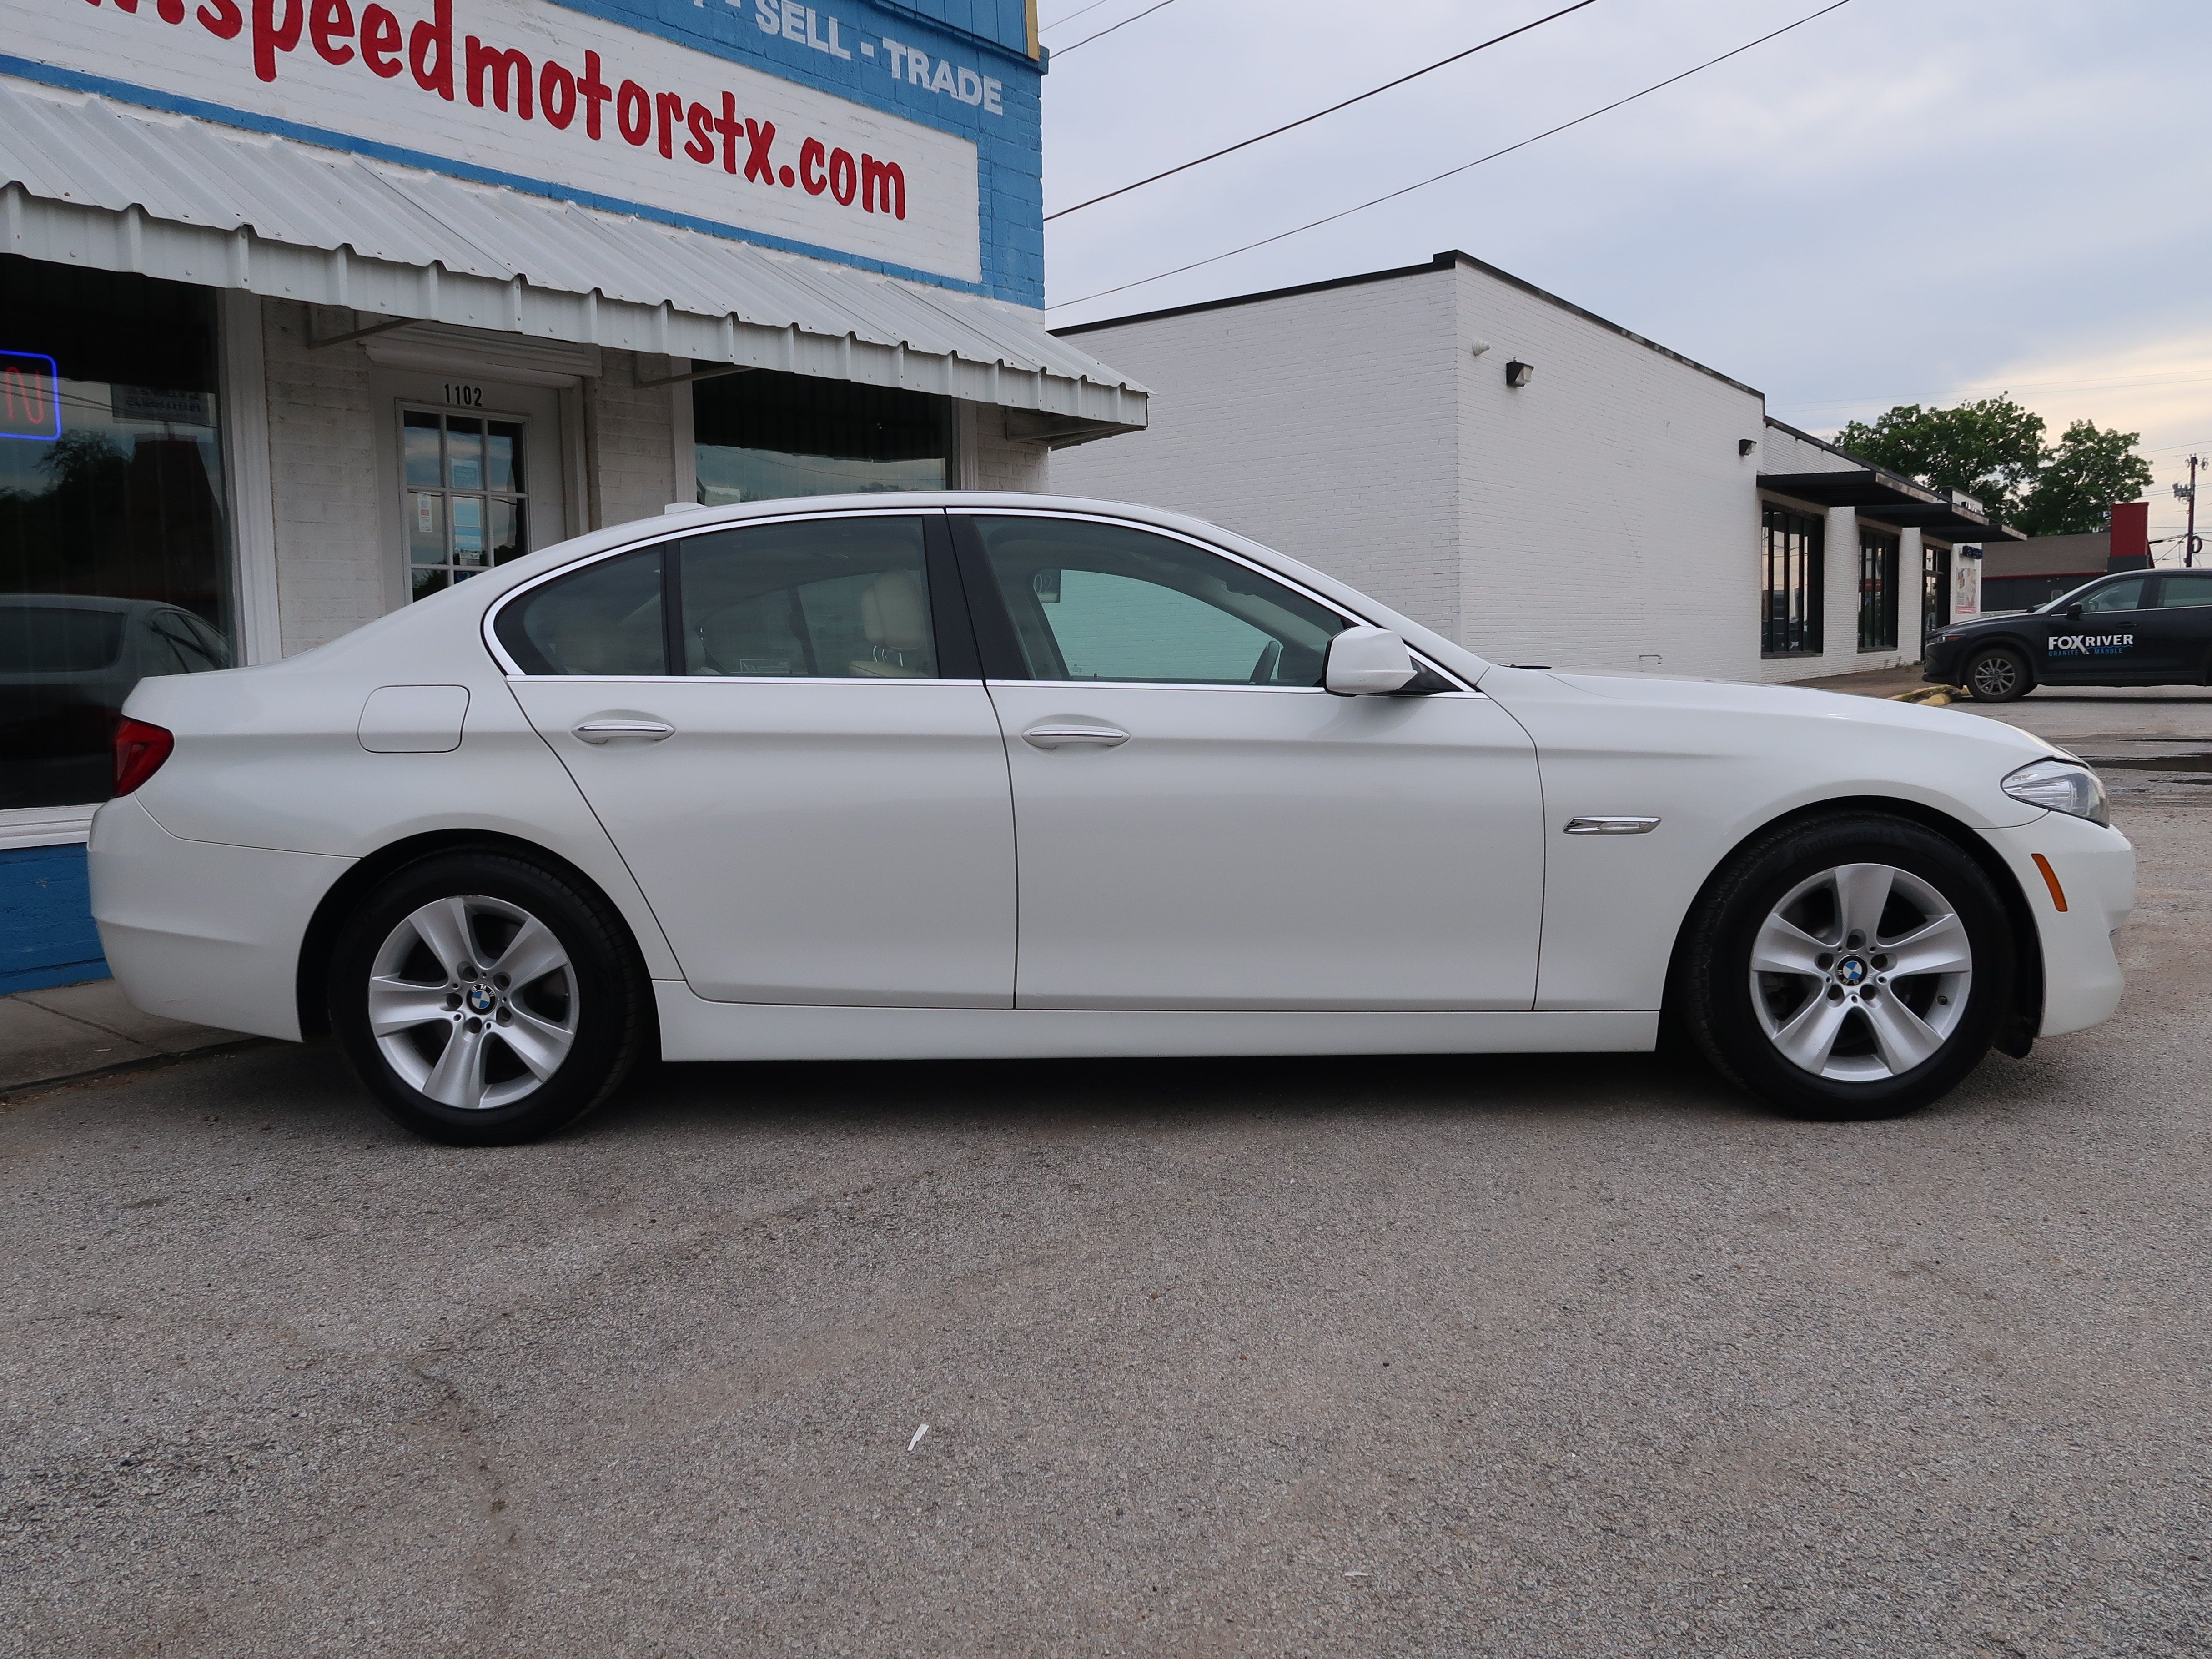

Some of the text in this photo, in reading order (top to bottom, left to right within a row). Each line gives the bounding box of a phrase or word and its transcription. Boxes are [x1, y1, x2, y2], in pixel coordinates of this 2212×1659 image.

[755, 0, 851, 60] SELL
[883, 37, 1003, 116] TRADE
[84, 0, 907, 220] .speedmotorstx.com
[445, 383, 482, 407] 1102
[2048, 634, 2133, 654] FOX RIVER
[1837, 969, 1859, 985] BMW
[471, 985, 495, 997] BMW
